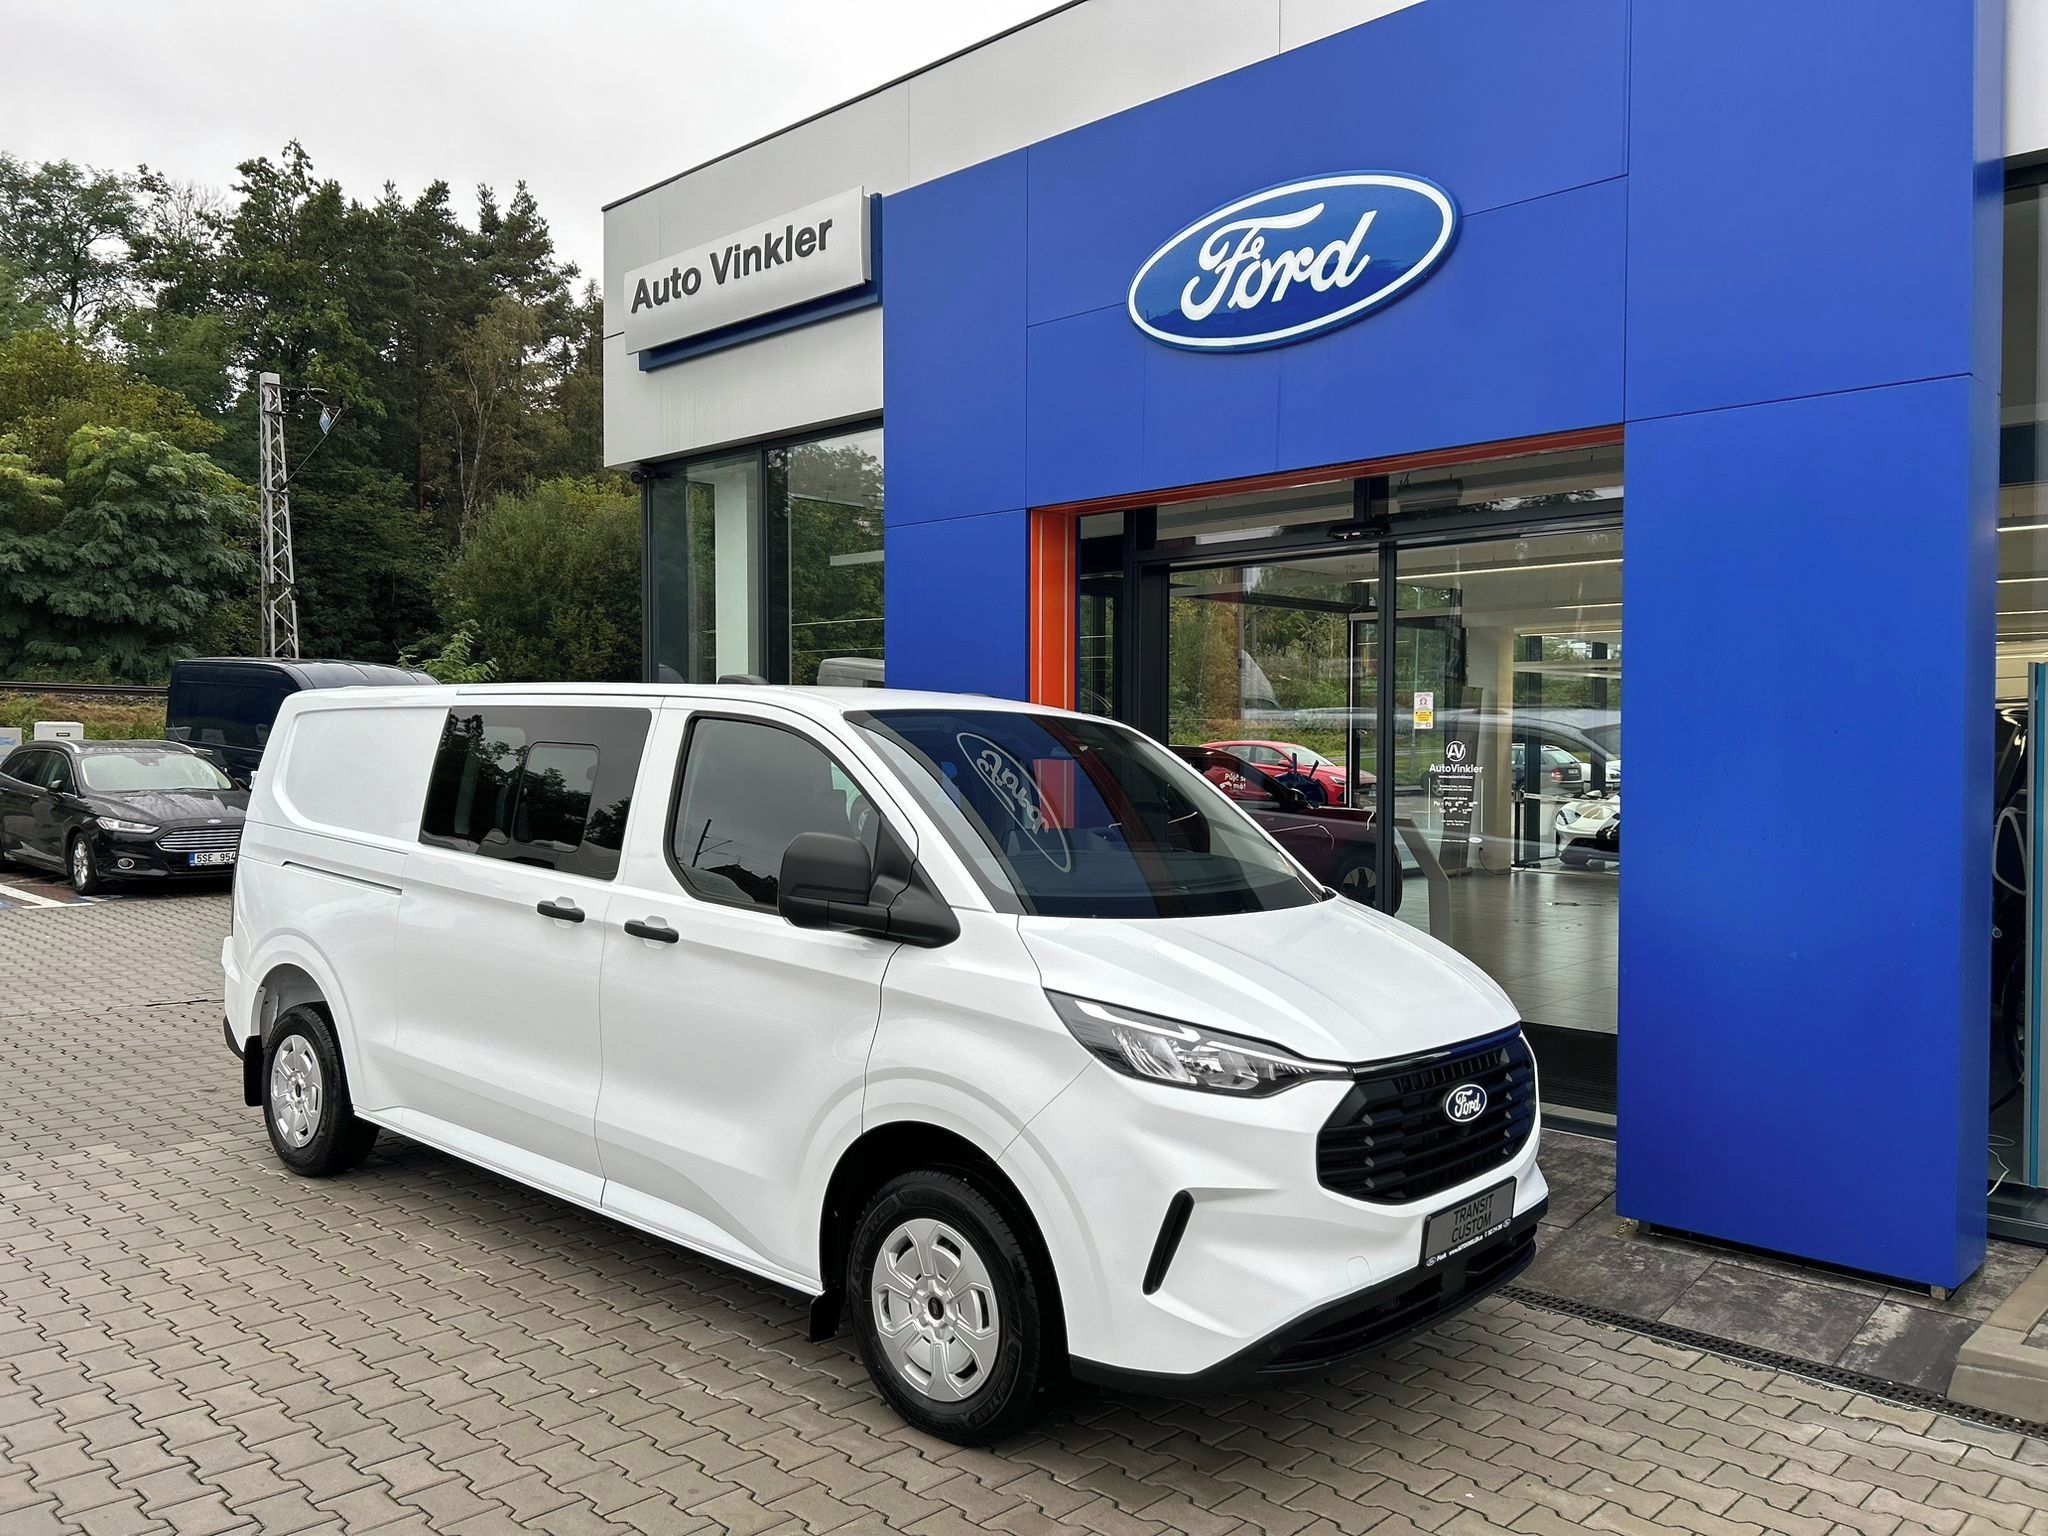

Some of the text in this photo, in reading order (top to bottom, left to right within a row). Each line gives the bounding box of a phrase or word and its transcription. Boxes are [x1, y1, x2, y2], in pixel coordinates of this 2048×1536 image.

[630, 218, 833, 314] Auto Vinkler
[1180, 202, 1378, 321] Ford
[1429, 763, 1484, 773] AutoVinkler
[196, 853, 214, 863] 5SE
[1454, 1089, 1481, 1118] Ford
[1453, 1193, 1494, 1226] TRANSIT
[1450, 1211, 1492, 1243] CUSTOM
